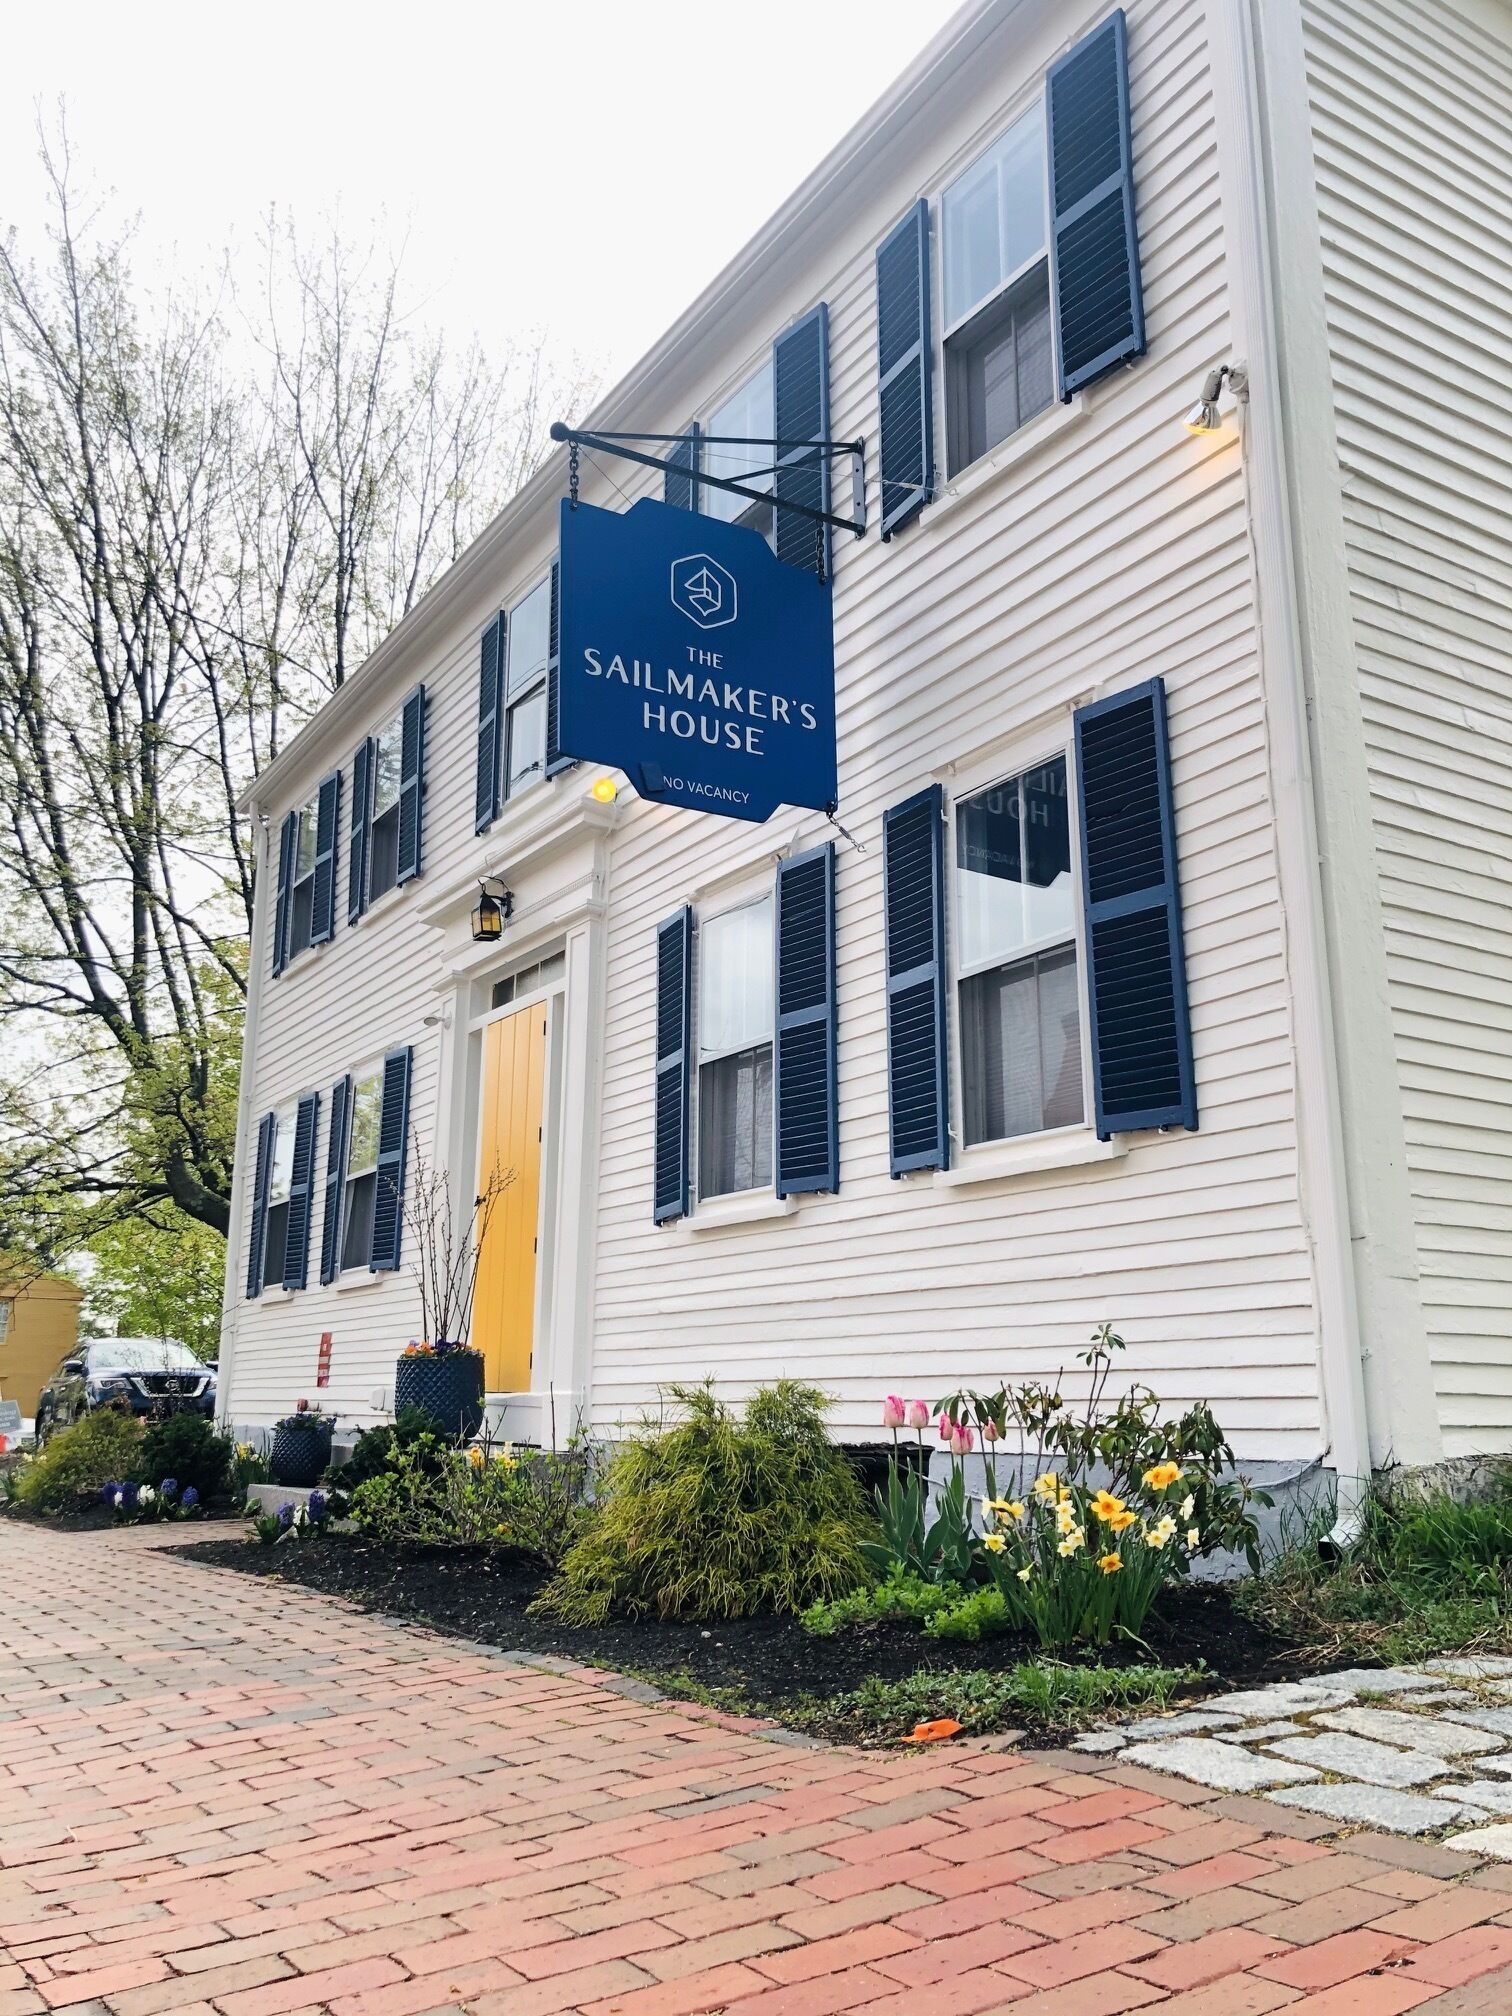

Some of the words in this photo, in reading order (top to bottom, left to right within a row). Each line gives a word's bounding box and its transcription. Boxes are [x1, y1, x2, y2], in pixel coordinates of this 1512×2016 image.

[686, 646, 724, 670] THE
[584, 648, 817, 730] SAILMAKER'S
[643, 701, 765, 756] HOUSE
[663, 775, 684, 790] NO
[687, 780, 750, 804] VACANCY
